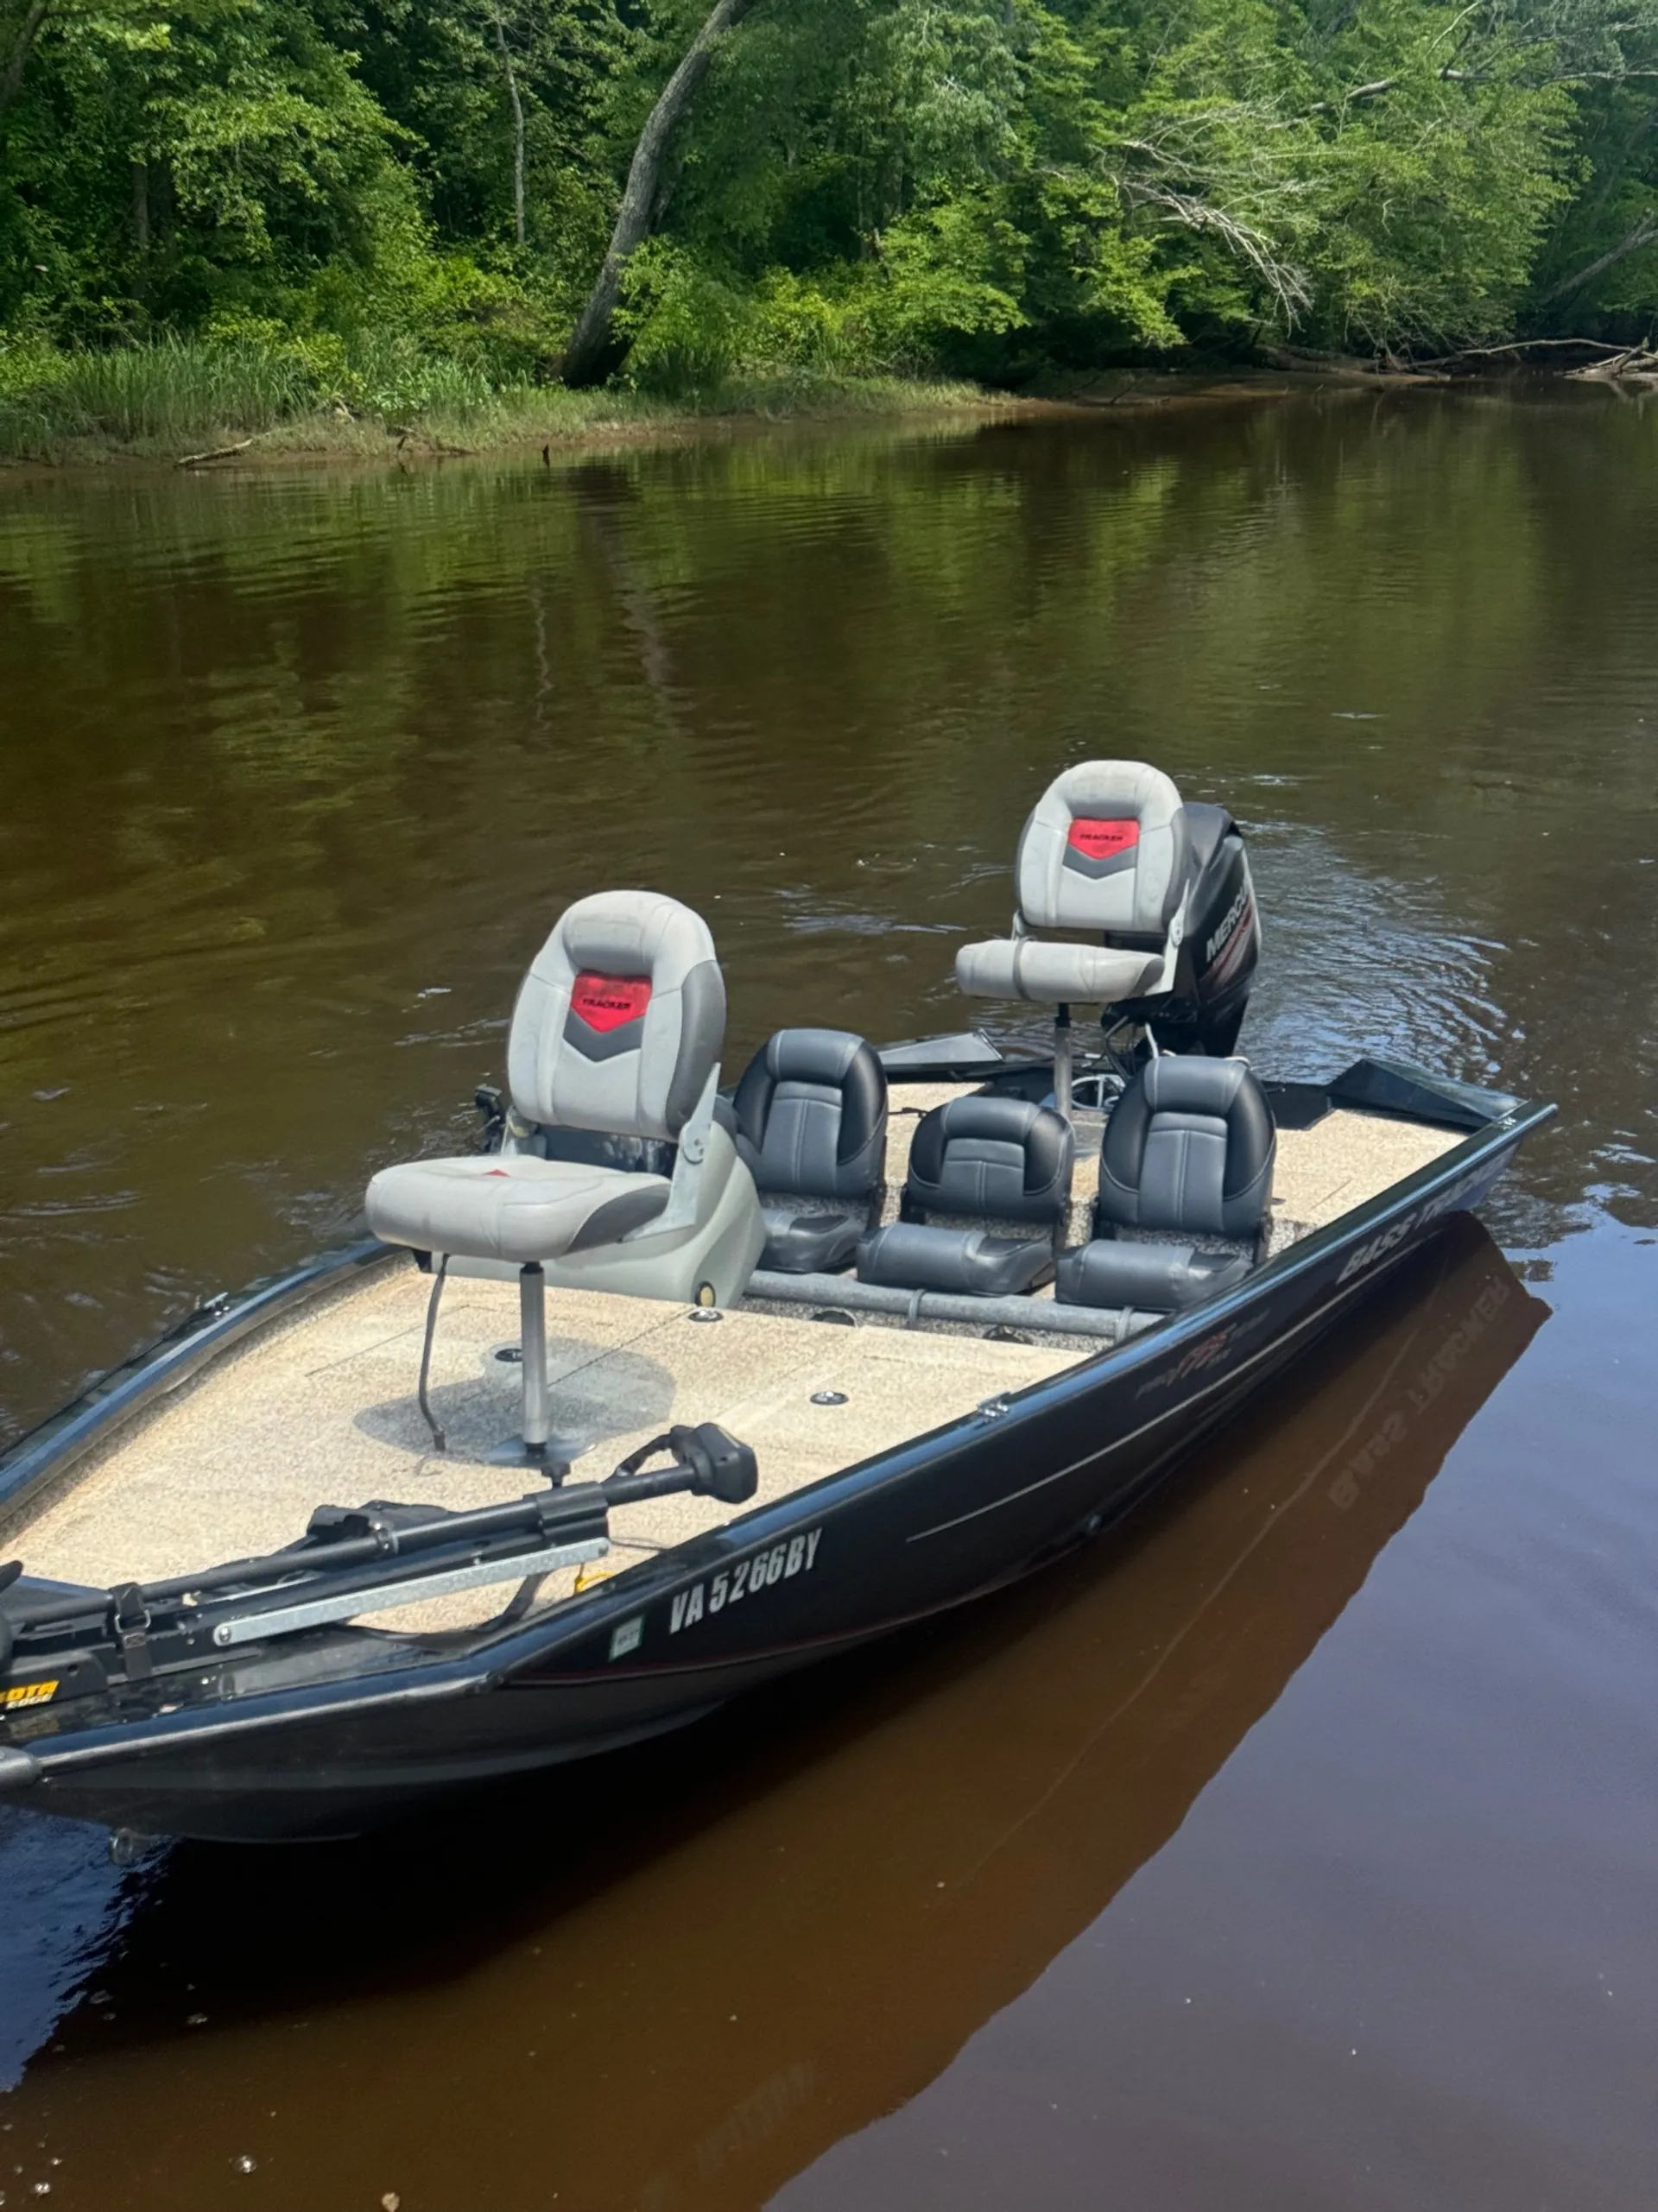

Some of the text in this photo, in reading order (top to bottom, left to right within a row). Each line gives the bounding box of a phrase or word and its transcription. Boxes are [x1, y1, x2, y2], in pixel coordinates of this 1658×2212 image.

[583, 998, 630, 1009] TRACKER
[669, 1526, 823, 1634] VA 5266BY
